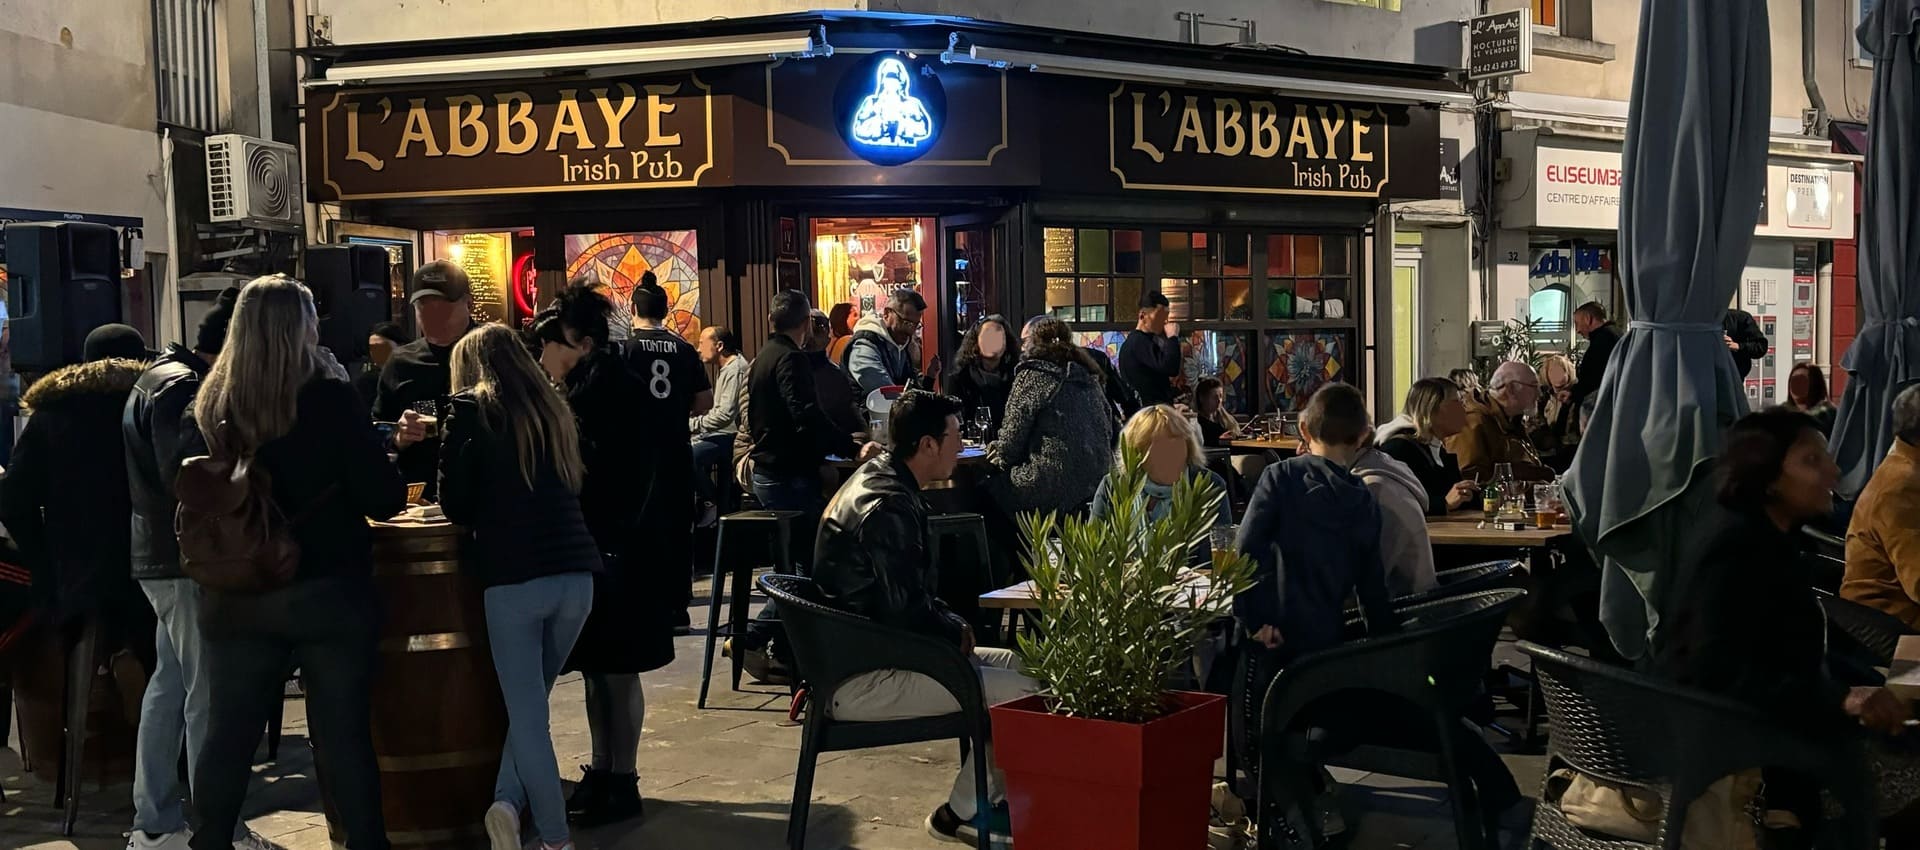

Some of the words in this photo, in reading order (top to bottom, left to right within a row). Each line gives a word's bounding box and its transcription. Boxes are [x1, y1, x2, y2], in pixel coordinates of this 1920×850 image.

[1473, 37, 1518, 50] NOCTURNE
[1485, 45, 1518, 55] VENDREDI
[1492, 62, 1499, 70] 43
[1501, 61, 1509, 69] 49
[1510, 60, 1517, 68] 37
[344, 82, 682, 171] L'ABBAYE
[1131, 90, 1374, 163] L'ABBAYE
[560, 154, 620, 182] Irish
[630, 150, 683, 180] Pub
[1291, 161, 1333, 188] Irish
[1338, 163, 1372, 190] Pub
[1790, 173, 1829, 184] DESTINATION
[1546, 192, 1580, 205] CENTRE
[1508, 251, 1519, 262] 32
[639, 339, 678, 353] TONTON
[650, 359, 671, 399] 8
